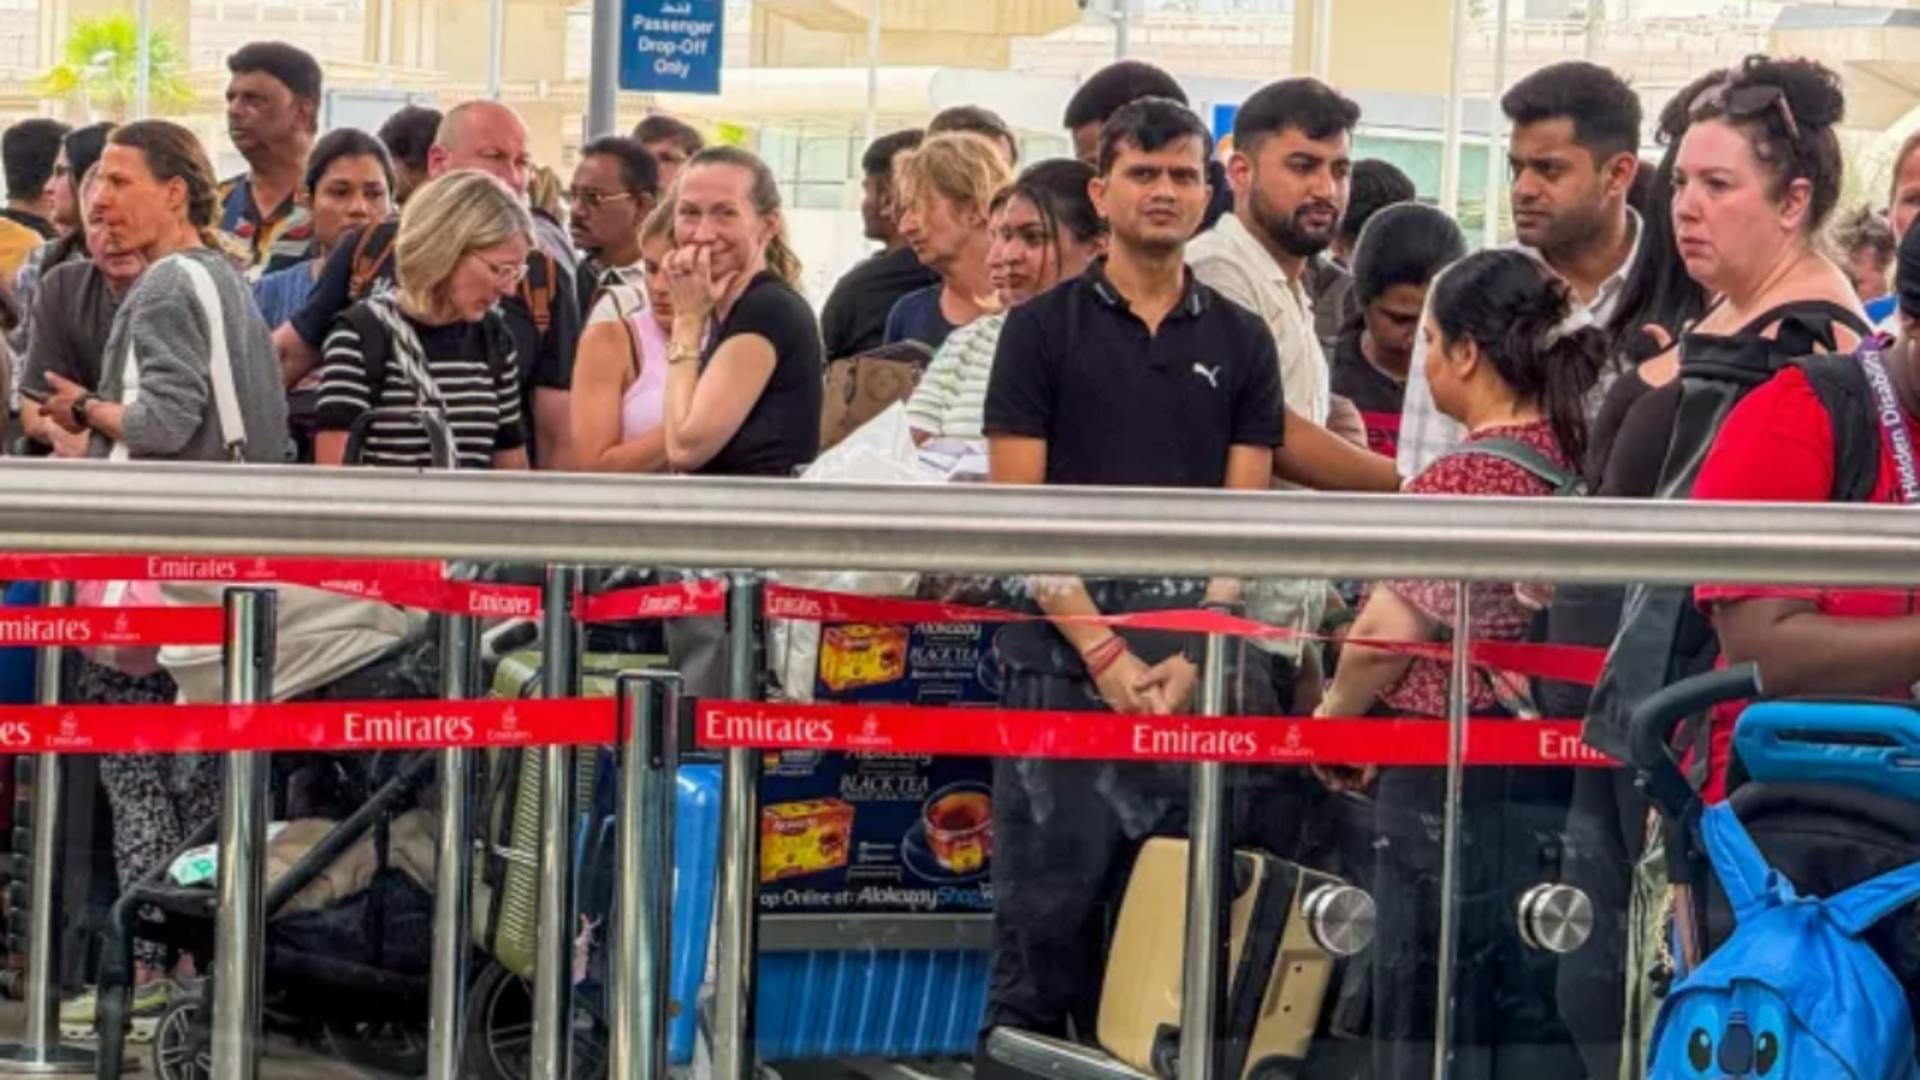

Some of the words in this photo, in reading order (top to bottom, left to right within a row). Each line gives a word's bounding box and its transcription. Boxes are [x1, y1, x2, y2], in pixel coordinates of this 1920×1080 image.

[632, 14, 715, 36] Passenger
[638, 36, 708, 56] Drop-Off
[653, 58, 691, 78] Only
[1891, 428, 1918, 499] Hidden
[147, 556, 237, 579] Emirates
[468, 589, 532, 614] Emirates
[766, 590, 823, 617] Emirates
[0, 614, 91, 641] mirates
[343, 711, 474, 742] Emirates
[706, 710, 834, 743] Emirates
[1133, 723, 1258, 756] Emirates
[839, 774, 893, 793] BLACK
[898, 775, 929, 793] TEA
[760, 893, 780, 909] op
[783, 889, 832, 906] Online
